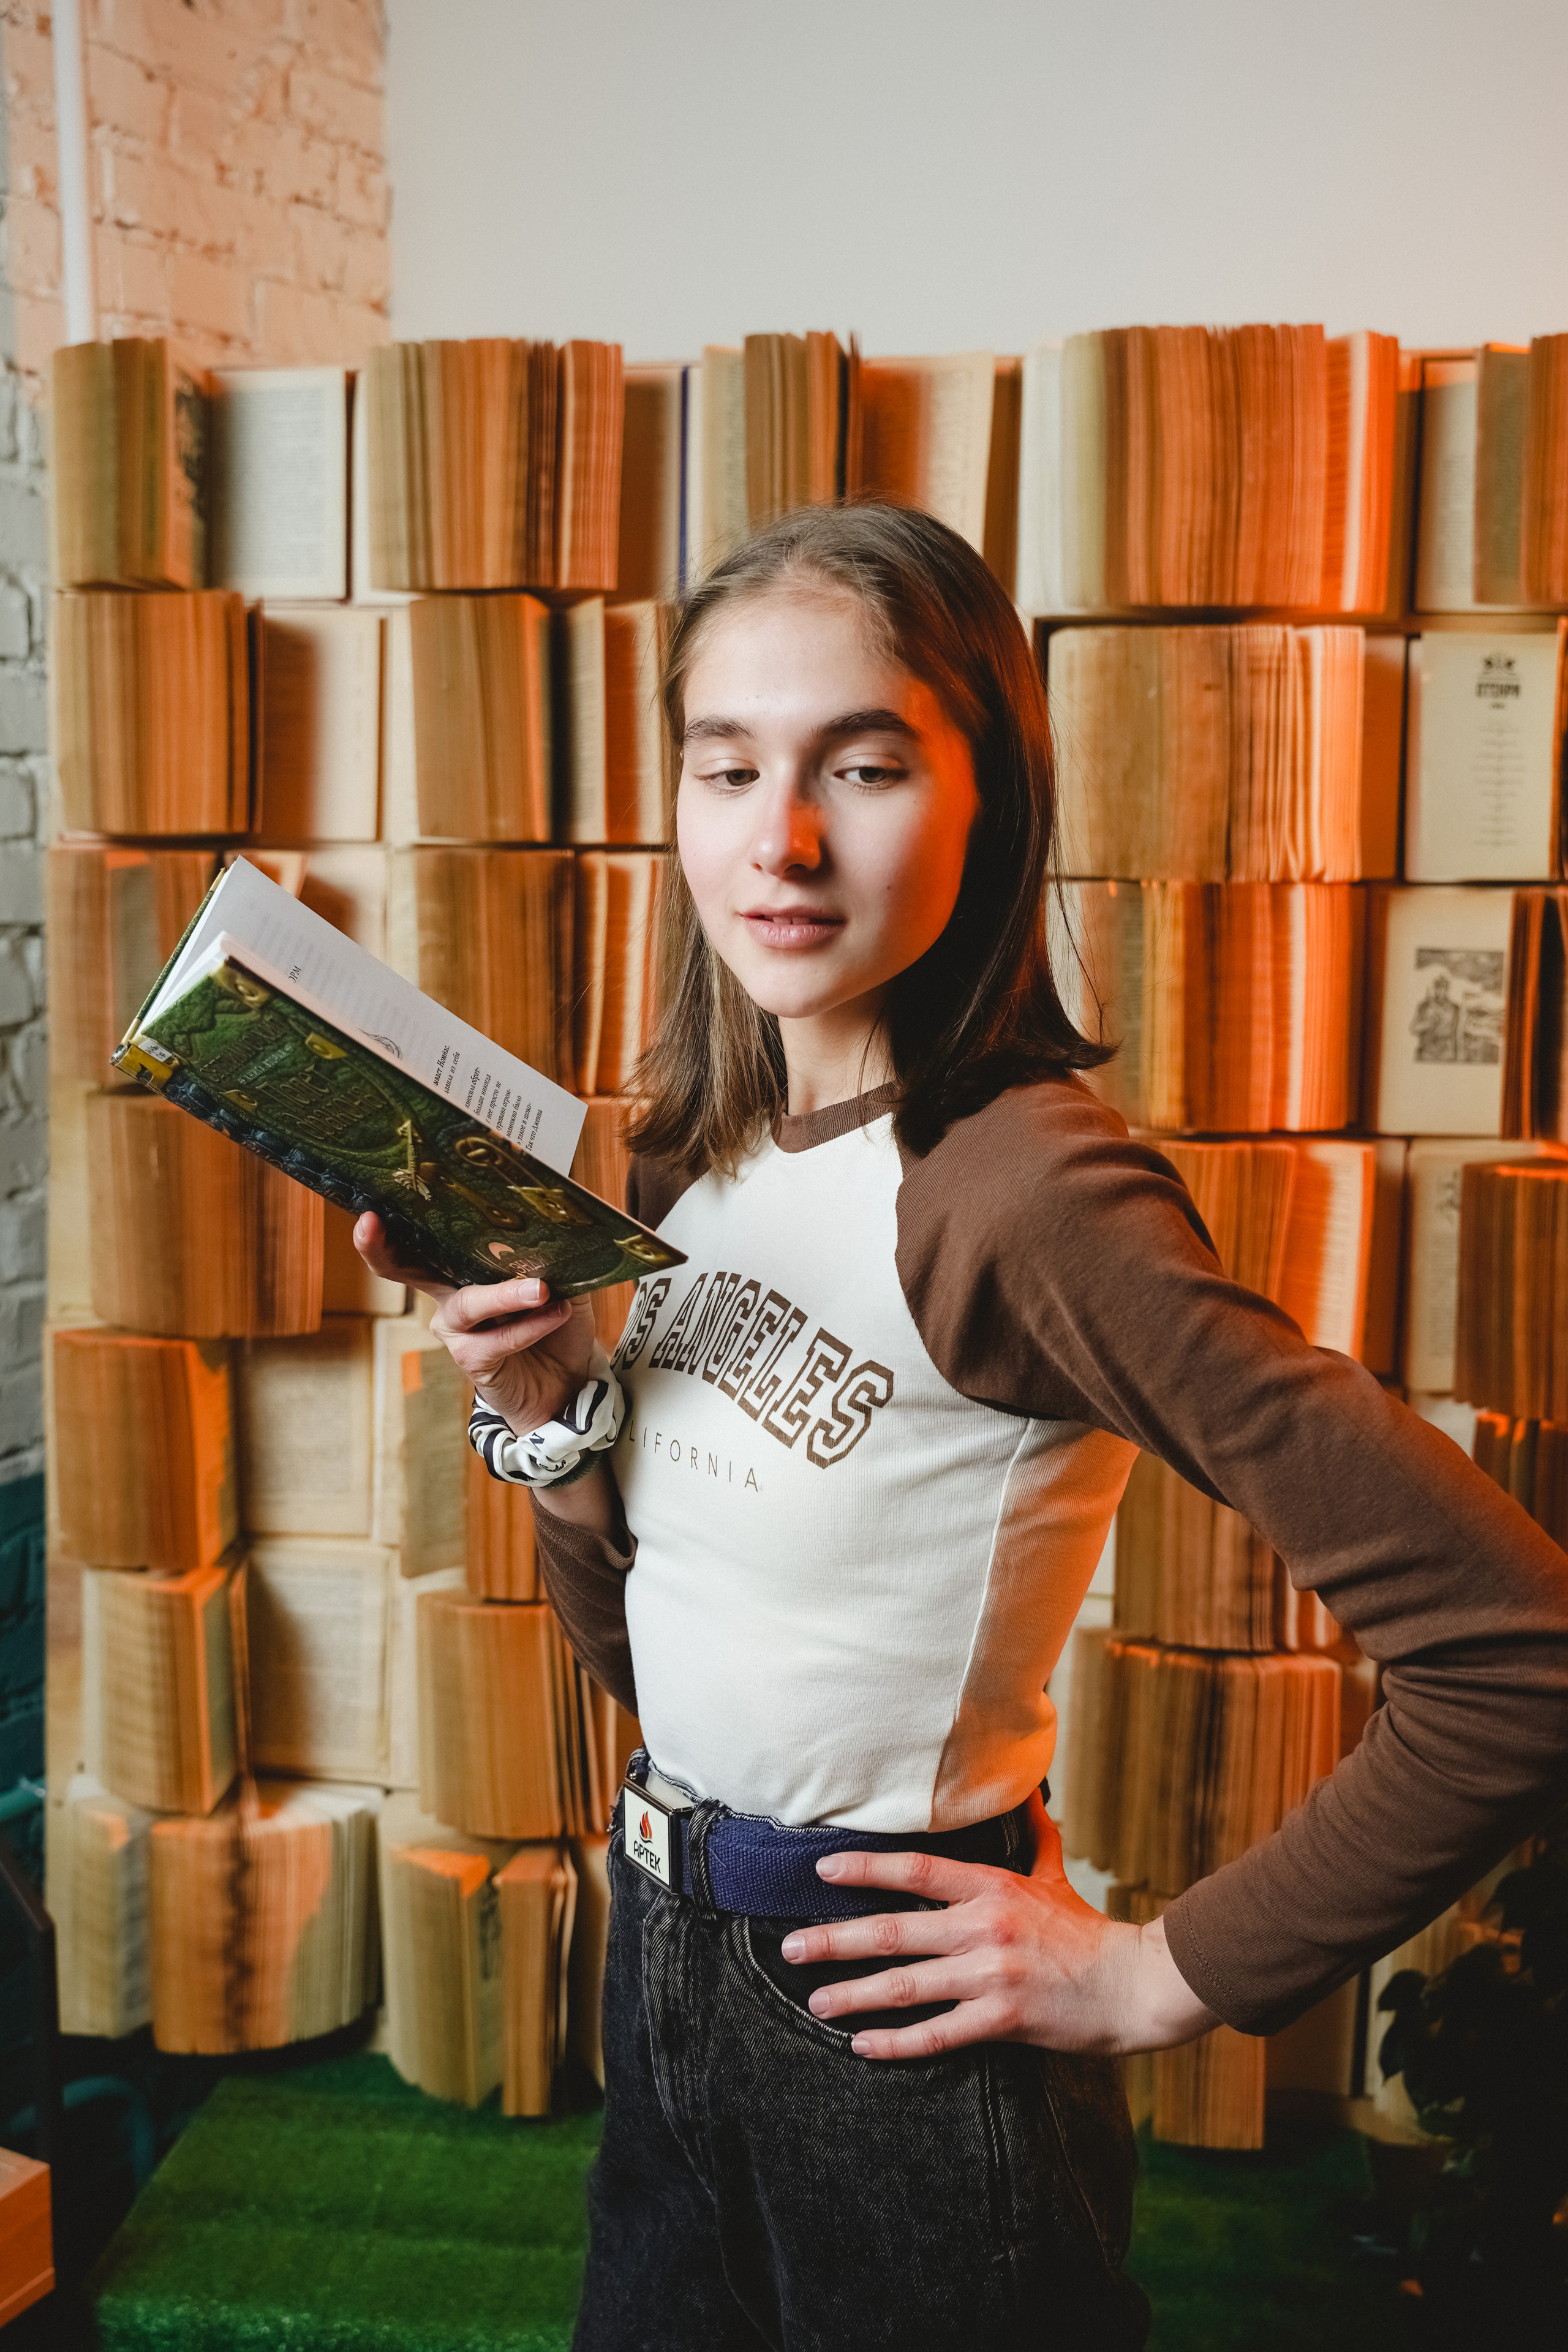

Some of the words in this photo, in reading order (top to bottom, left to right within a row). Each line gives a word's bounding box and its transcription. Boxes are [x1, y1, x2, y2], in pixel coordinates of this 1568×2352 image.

[450, 1065, 456, 1074] из
[470, 1066, 480, 1085] обрат-
[473, 1095, 484, 1116] больше
[481, 1074, 491, 1096] никогда
[489, 1088, 499, 1109] просто
[496, 1080, 502, 1089] не
[502, 1088, 511, 1107] огром-
[506, 1110, 518, 1138] возможно
[513, 1095, 522, 1110] было
[517, 1125, 526, 1140] такое
[523, 1102, 532, 1120] шоко-
[525, 1140, 533, 1152] Так
[531, 1109, 543, 1133] Дженна
[649, 1272, 894, 1469] ANGELES
[629, 1420, 758, 1492] LIFORNIA
[633, 1840, 661, 1873] APTEK
